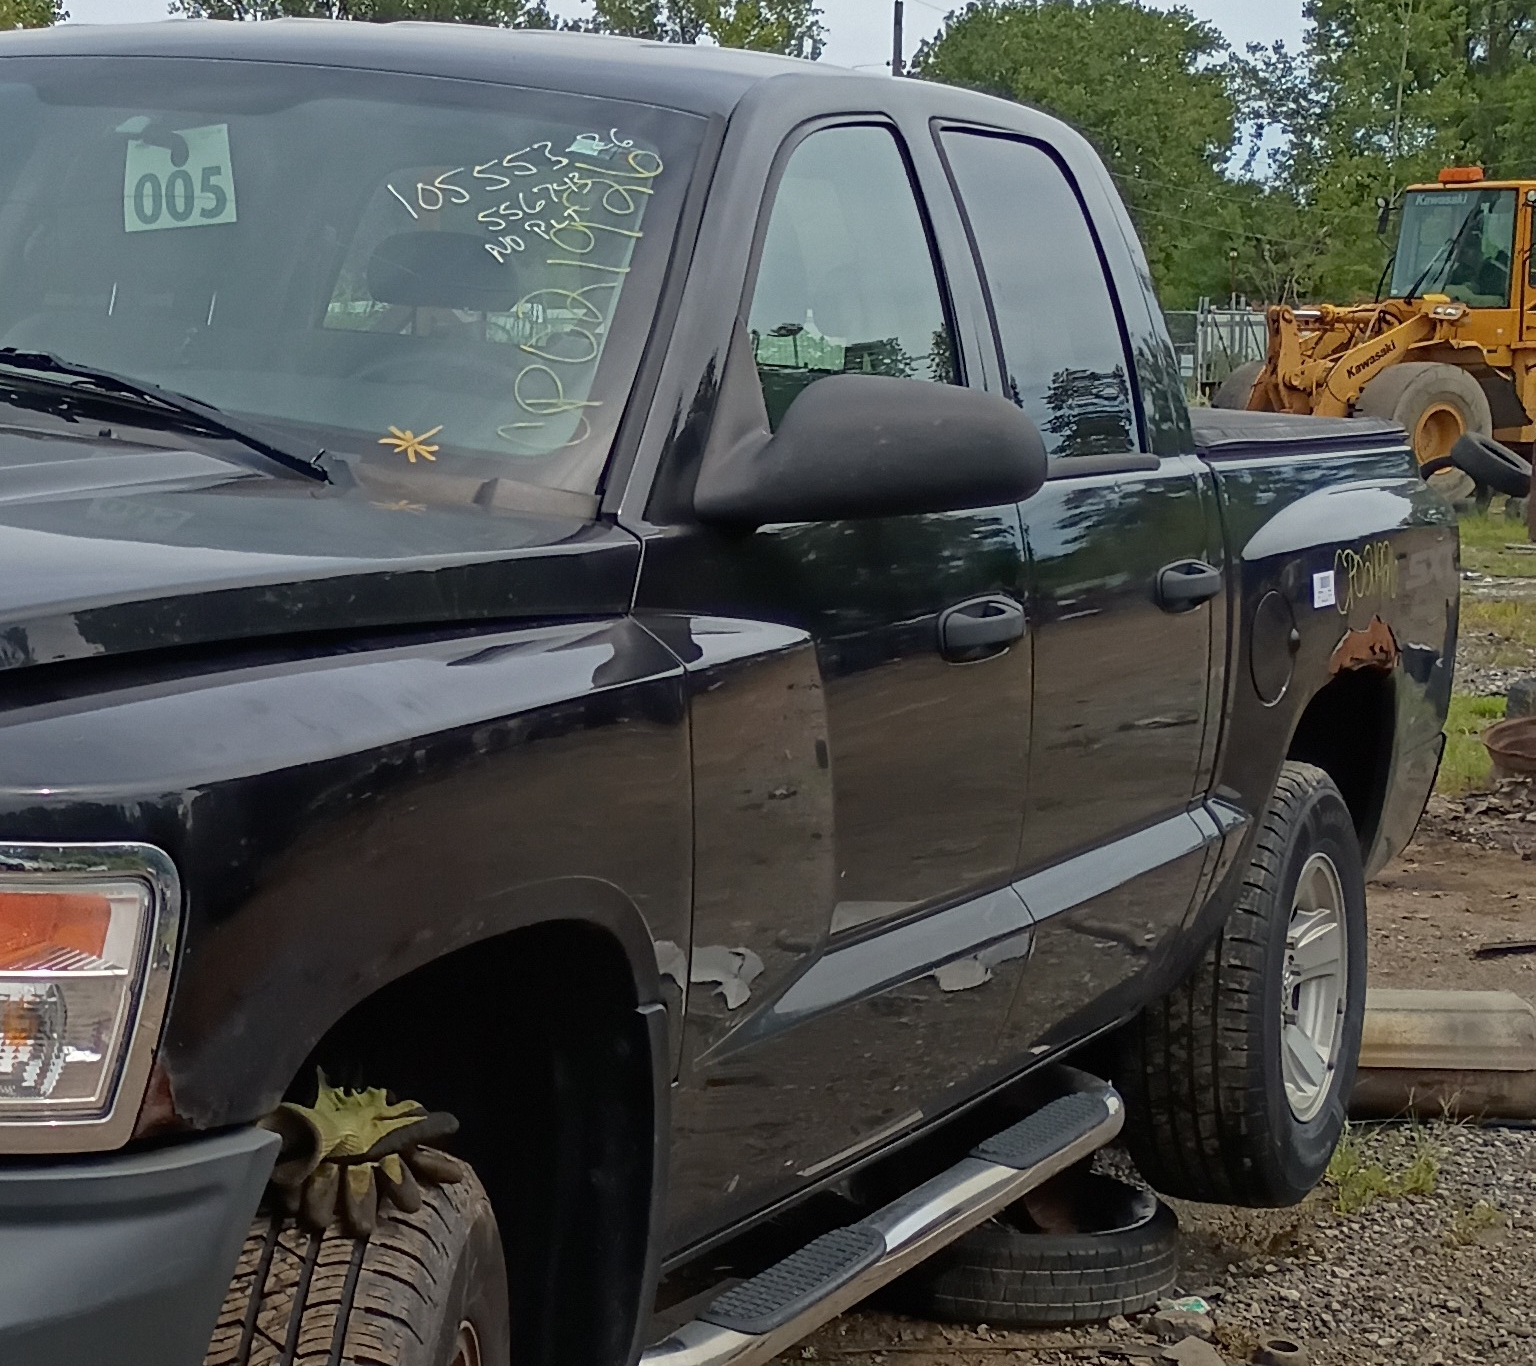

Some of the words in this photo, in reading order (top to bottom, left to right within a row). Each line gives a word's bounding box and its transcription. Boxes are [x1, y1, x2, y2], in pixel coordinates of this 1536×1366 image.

[133, 165, 228, 225] 005
[477, 172, 592, 230] 556743
[1415, 193, 1469, 206] Kawasaki
[485, 236, 525, 263] NO
[1346, 339, 1396, 379] Kawasaki
